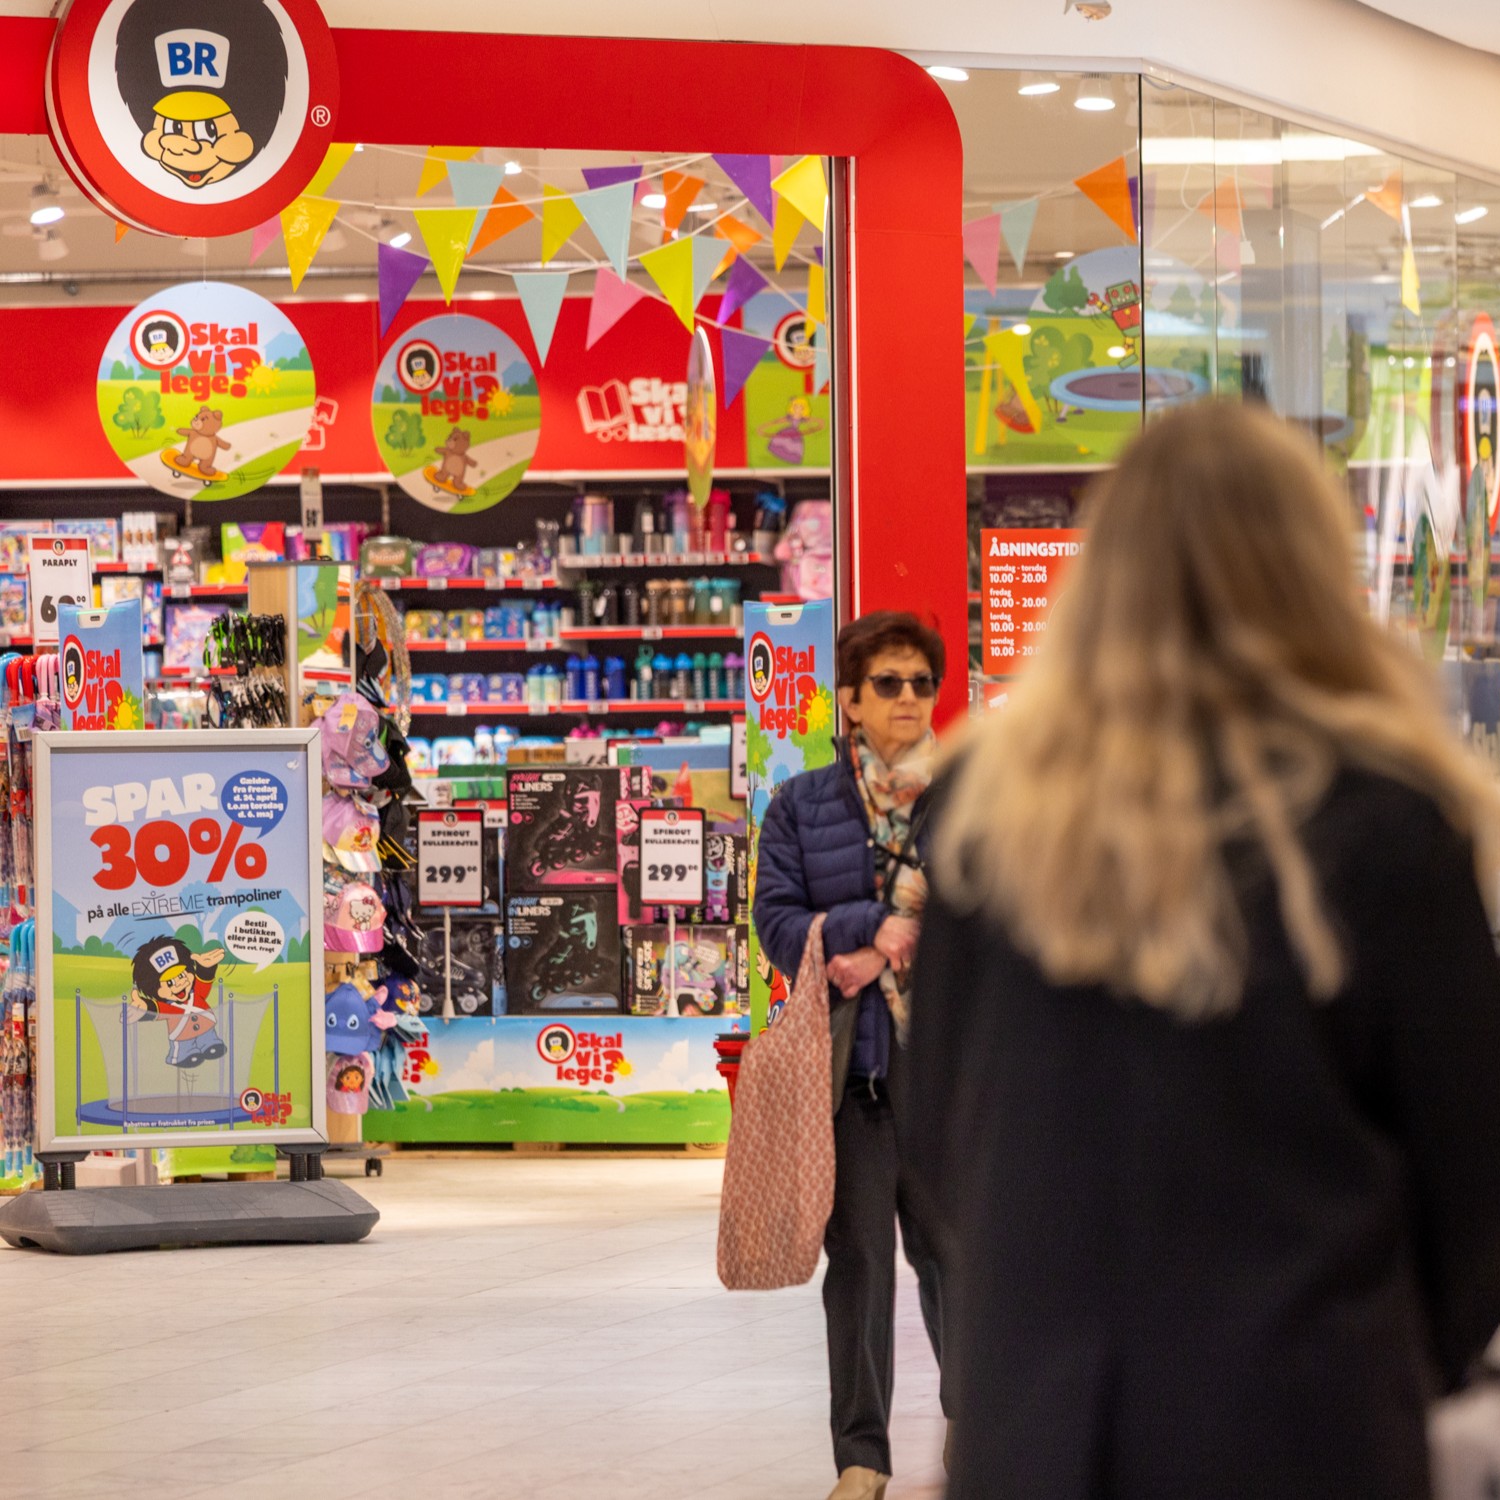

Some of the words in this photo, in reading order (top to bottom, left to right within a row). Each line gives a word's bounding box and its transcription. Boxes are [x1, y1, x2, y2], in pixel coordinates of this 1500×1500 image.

[167, 41, 219, 77] BR
[190, 323, 258, 346] Skal
[443, 352, 497, 372] Skal
[629, 378, 688, 405] Ska
[42, 559, 78, 567] PARAPLY
[989, 564, 1016, 573] mandag
[1021, 564, 1047, 573] torsdag
[989, 573, 1014, 583] 10.00
[1022, 573, 1047, 583] 20.00
[989, 588, 1012, 598] fredag
[990, 598, 1014, 608] 10.00
[1022, 598, 1047, 608] 20.00
[41, 595, 76, 623] 6
[990, 622, 1014, 632] 10.00
[990, 647, 1015, 656] 10.00
[86, 648, 121, 679] Skal
[776, 645, 815, 674] Skal
[247, 785, 278, 795] fredag
[83, 773, 218, 826] SPAR
[256, 793, 277, 802] april
[250, 802, 284, 811] torsdag
[256, 810, 274, 819] maj
[90, 818, 267, 890] 30%
[425, 865, 466, 883] 299
[647, 864, 687, 881] 299
[87, 904, 104, 923] på
[107, 902, 130, 917] alle
[131, 891, 205, 917] EXTREME
[206, 888, 282, 908] trampoliner
[244, 919, 268, 928] Bestil
[239, 927, 276, 937] butikken
[227, 934, 246, 942] eller
[247, 936, 257, 944] på
[258, 937, 282, 945] BR.dk
[155, 951, 176, 968] BR
[577, 1032, 623, 1048] Skal
[264, 1092, 291, 1103] Skal
